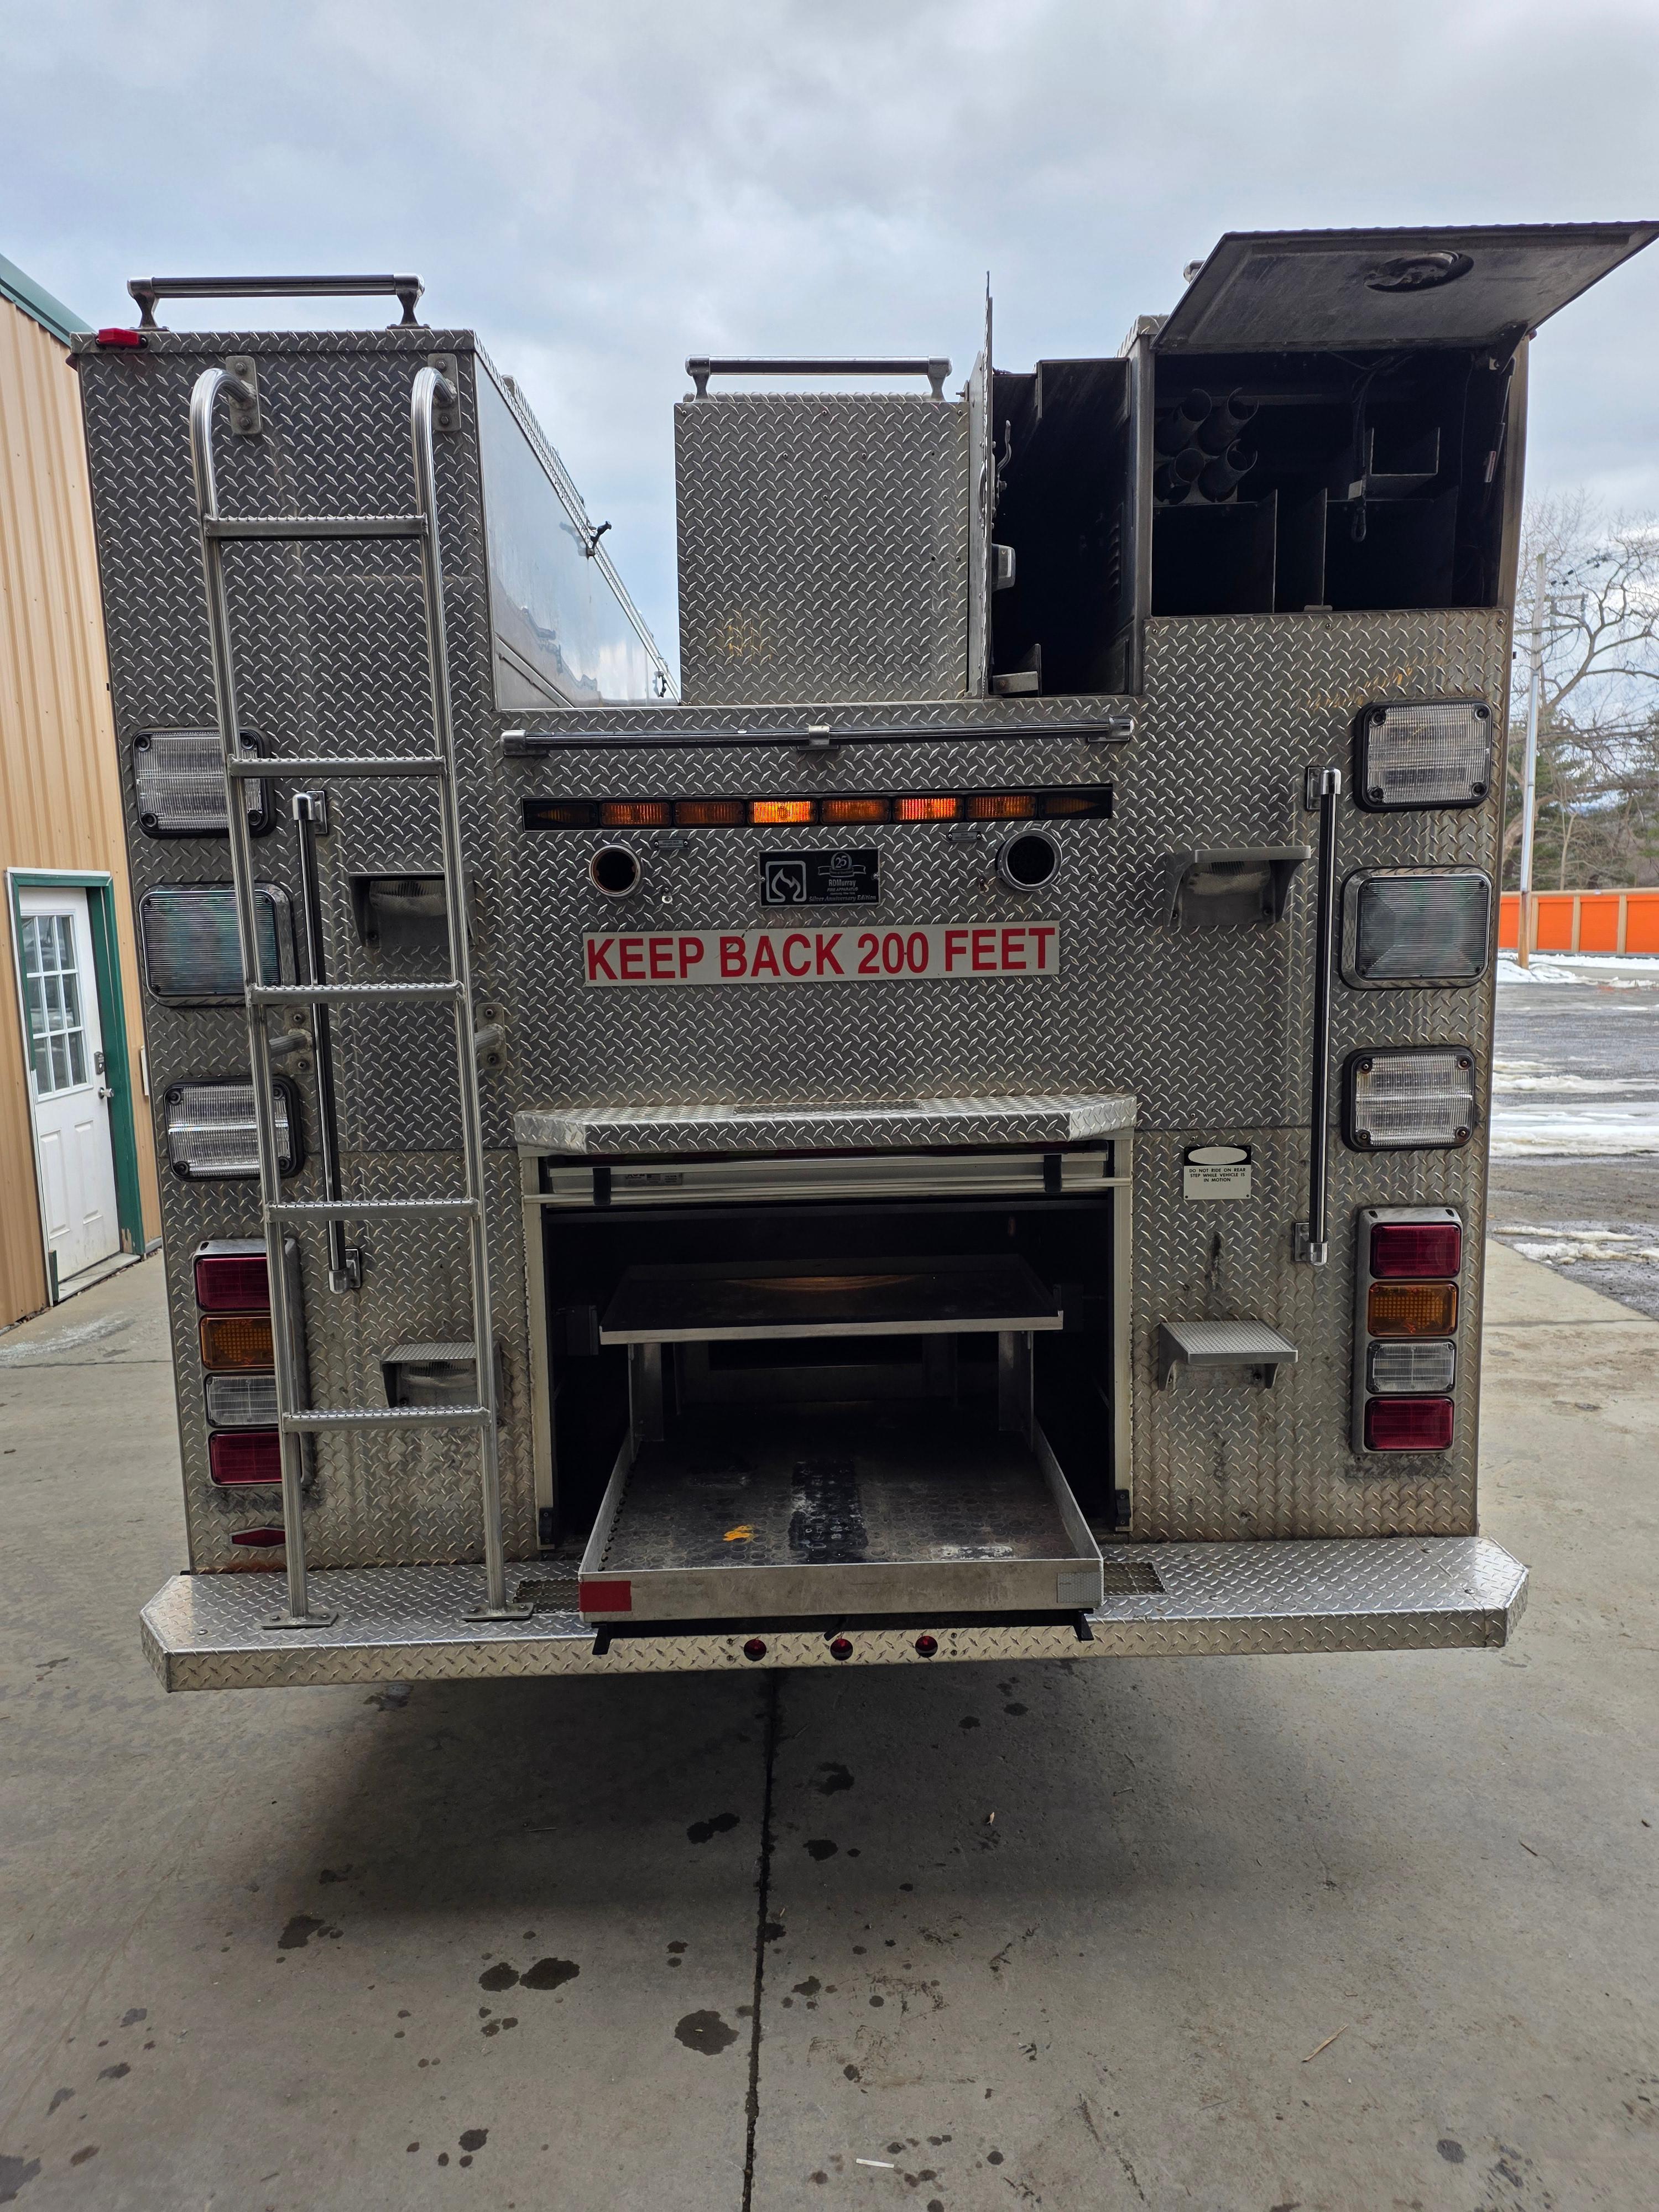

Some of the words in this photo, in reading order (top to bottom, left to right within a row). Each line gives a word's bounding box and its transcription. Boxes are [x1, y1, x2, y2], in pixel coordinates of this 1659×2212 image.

[835, 855, 847, 868] 25
[828, 879, 856, 887] RDMurray
[587, 936, 705, 980] KEEP
[719, 933, 845, 978] BACK
[857, 931, 929, 974] 200
[945, 927, 1055, 972] FEET
